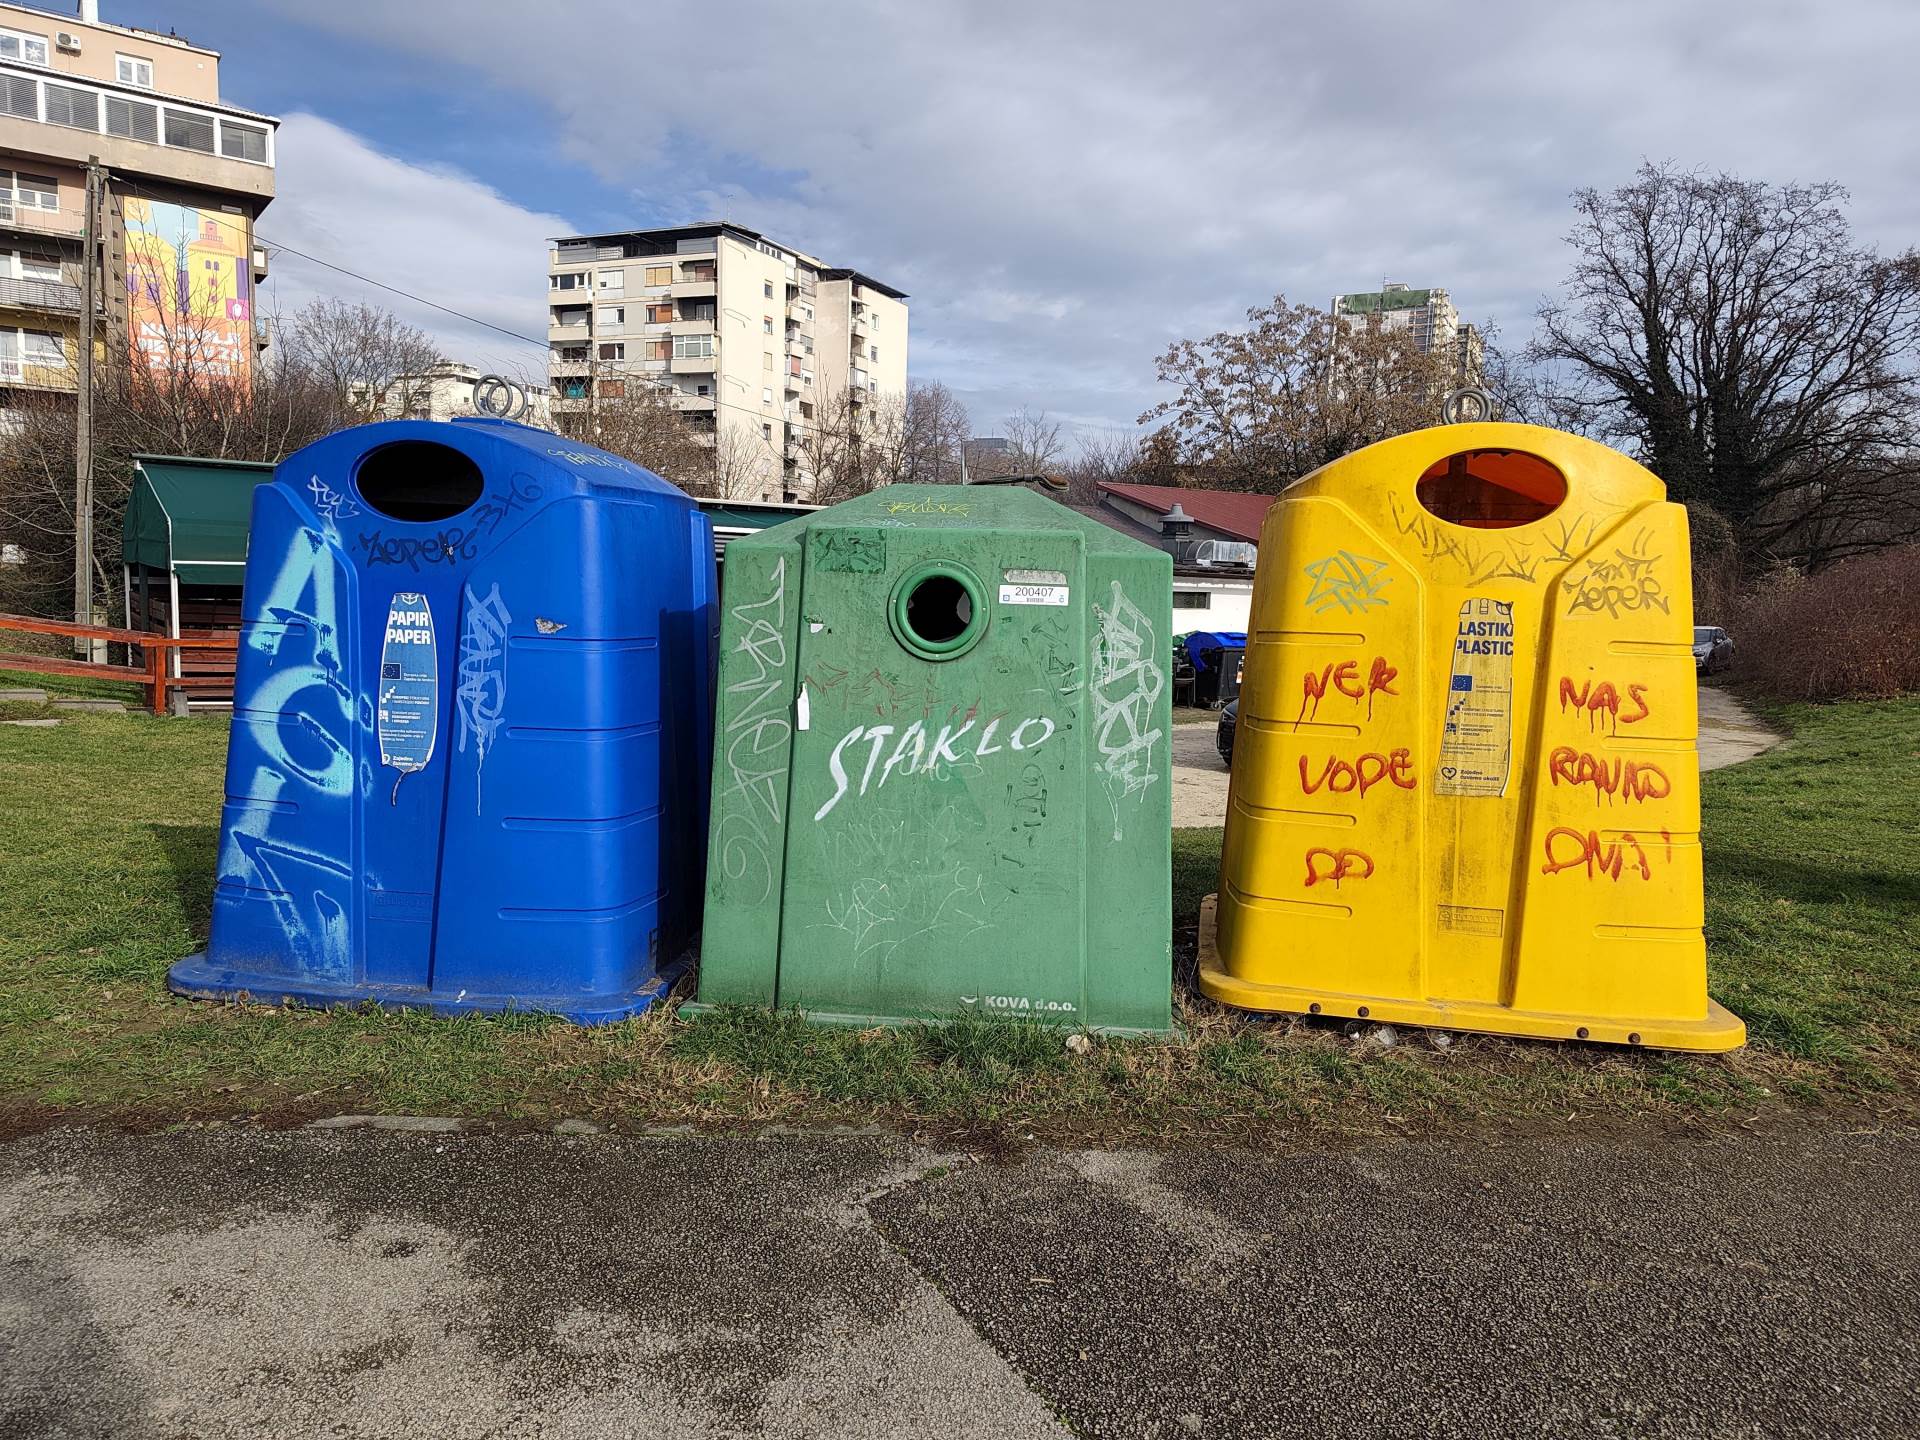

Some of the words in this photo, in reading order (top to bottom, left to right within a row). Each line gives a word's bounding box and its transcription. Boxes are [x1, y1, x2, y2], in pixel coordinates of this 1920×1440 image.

[1015, 586, 1055, 597] 200407
[389, 610, 429, 627] PAPIR
[387, 628, 431, 645] PAPER
[1560, 676, 1650, 728] NAS
[814, 716, 1055, 821] STAKLO
[1299, 748, 1417, 797] VODE
[985, 995, 1030, 1009] KOVA
[1035, 998, 1077, 1012] d.o.o.
